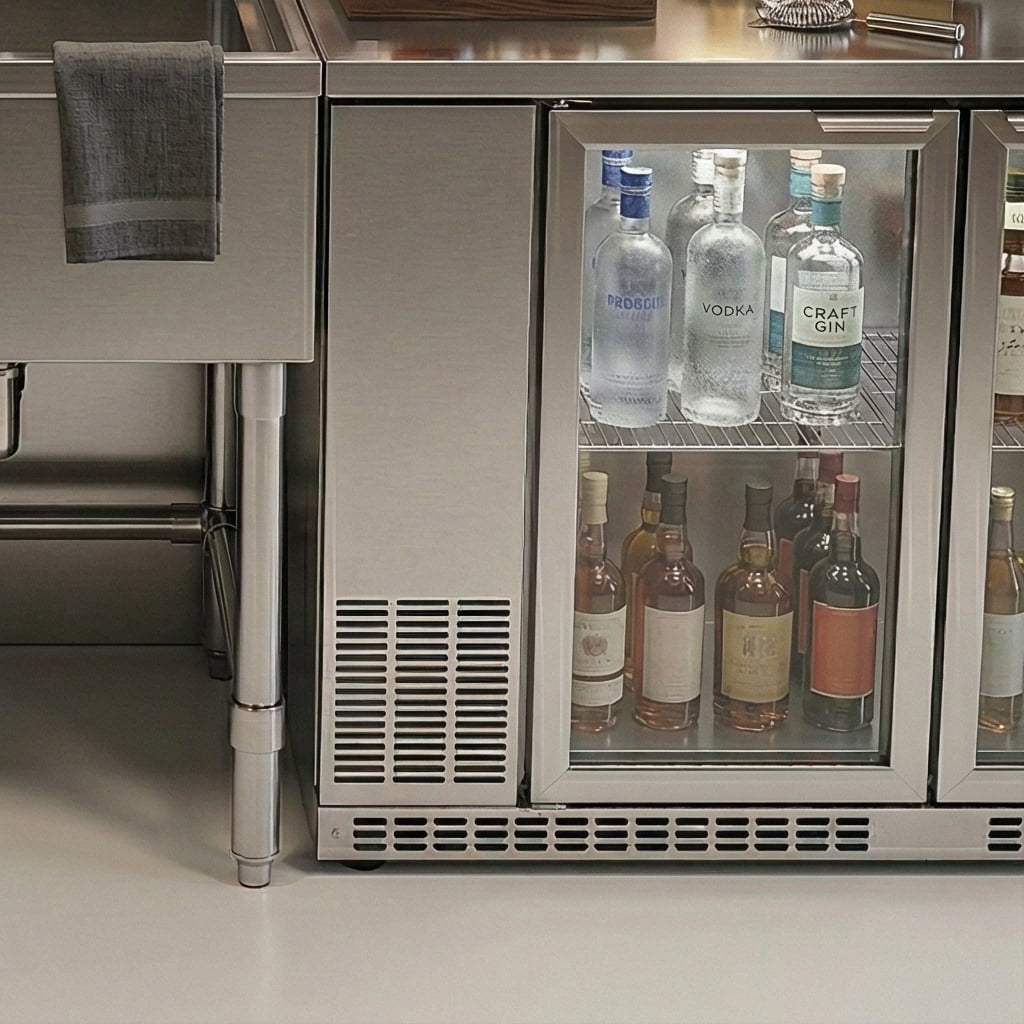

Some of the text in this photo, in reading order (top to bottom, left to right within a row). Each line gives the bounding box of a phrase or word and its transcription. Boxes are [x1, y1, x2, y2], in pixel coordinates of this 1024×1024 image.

[702, 302, 754, 317] VODKA
[803, 305, 858, 320] CRAFT
[814, 320, 845, 333] GIN
